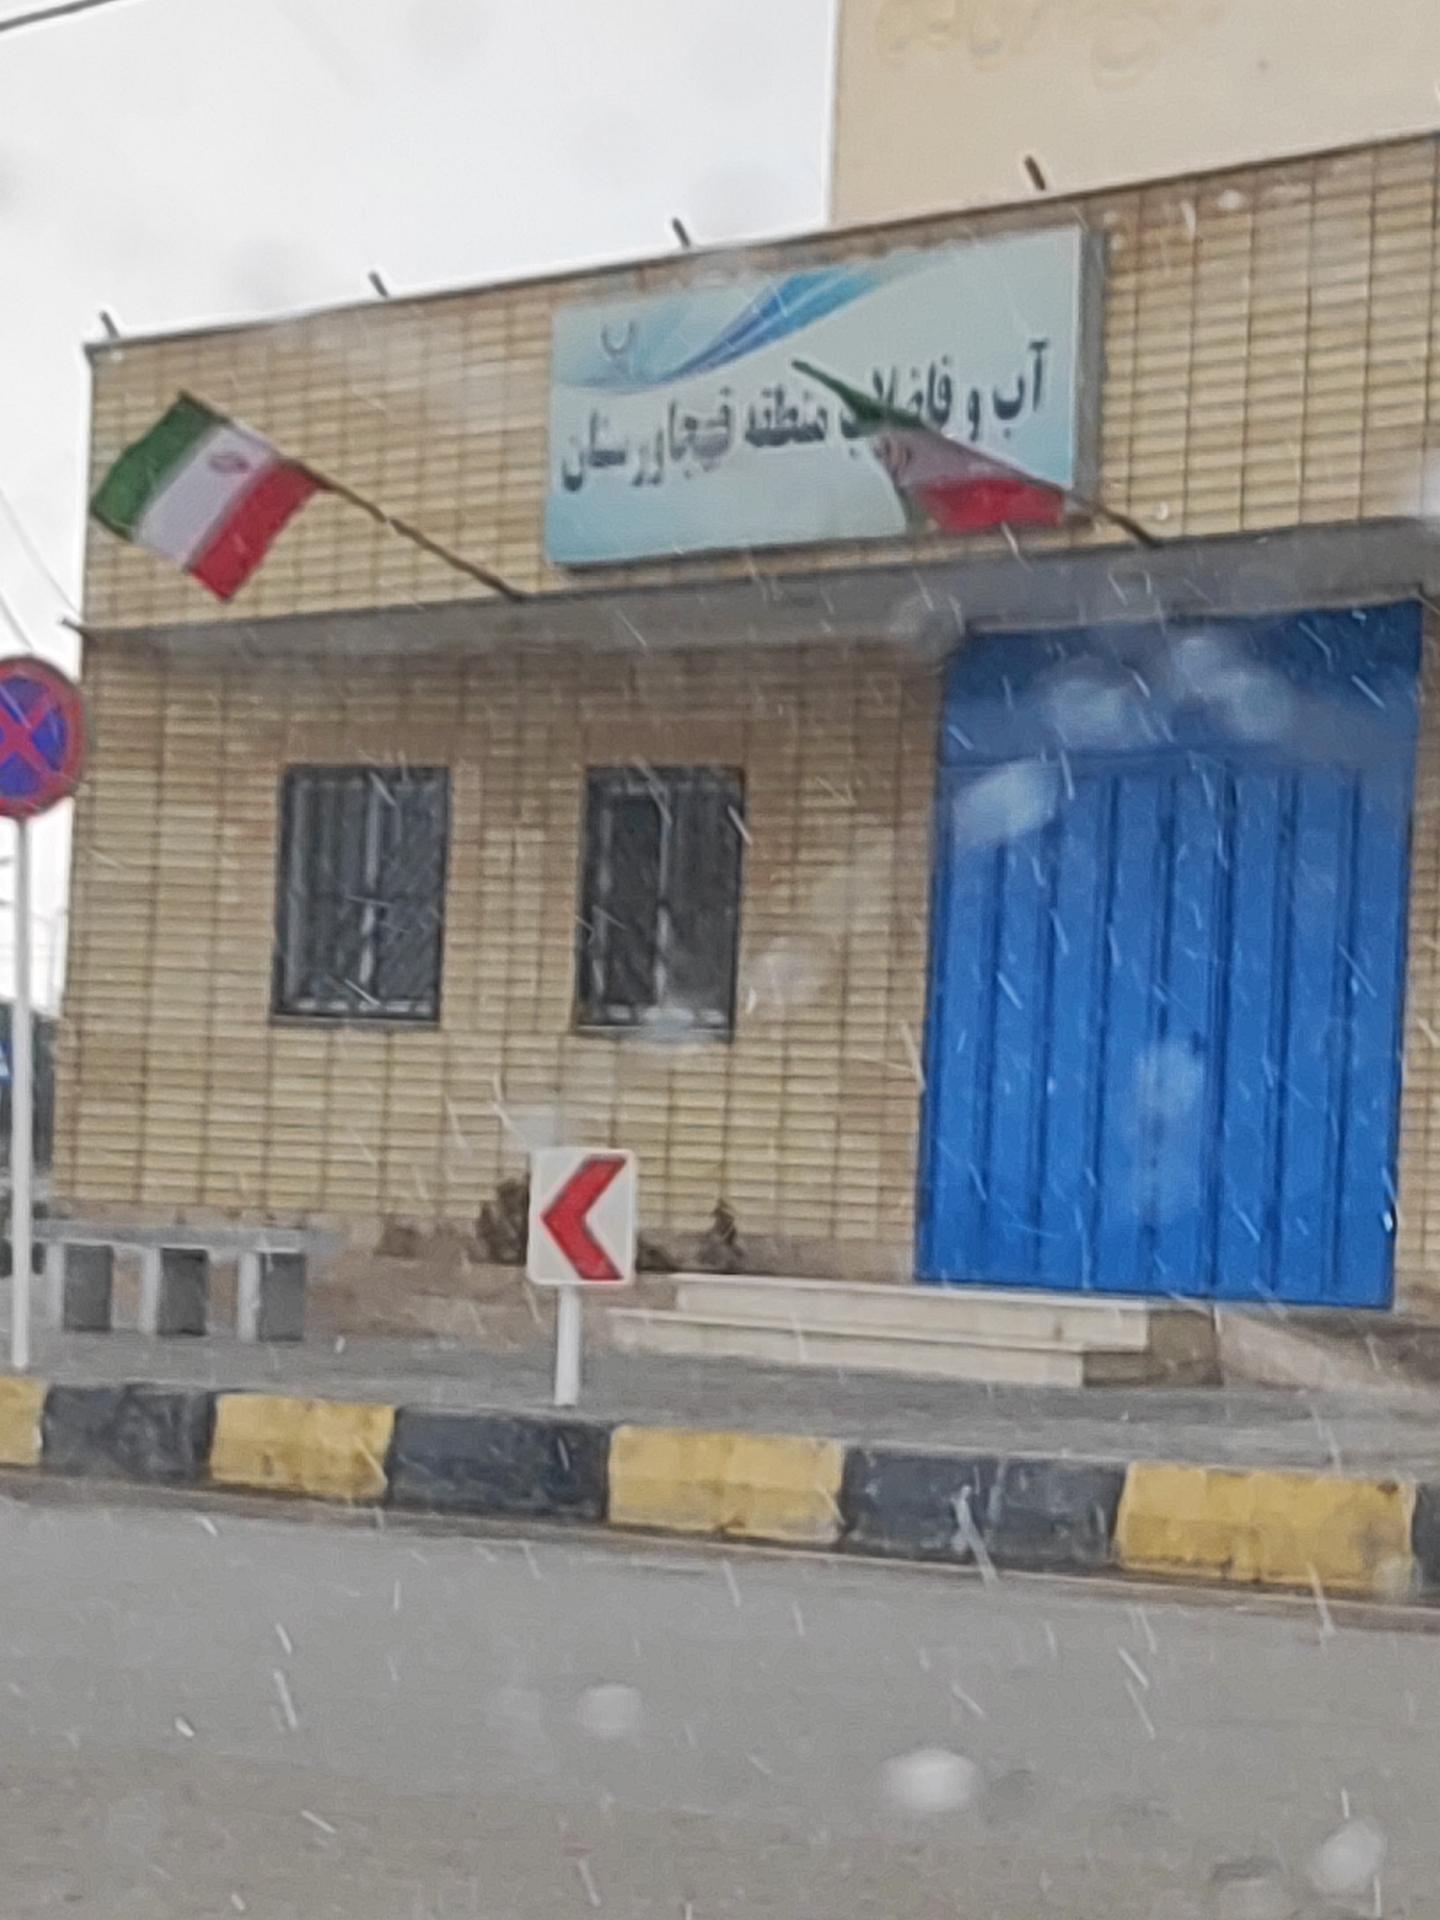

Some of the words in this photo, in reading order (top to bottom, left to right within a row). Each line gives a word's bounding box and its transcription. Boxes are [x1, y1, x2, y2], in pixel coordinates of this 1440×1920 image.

[745, 384, 828, 447] منطقه
[967, 387, 981, 442] و
[992, 339, 1047, 439] آب
